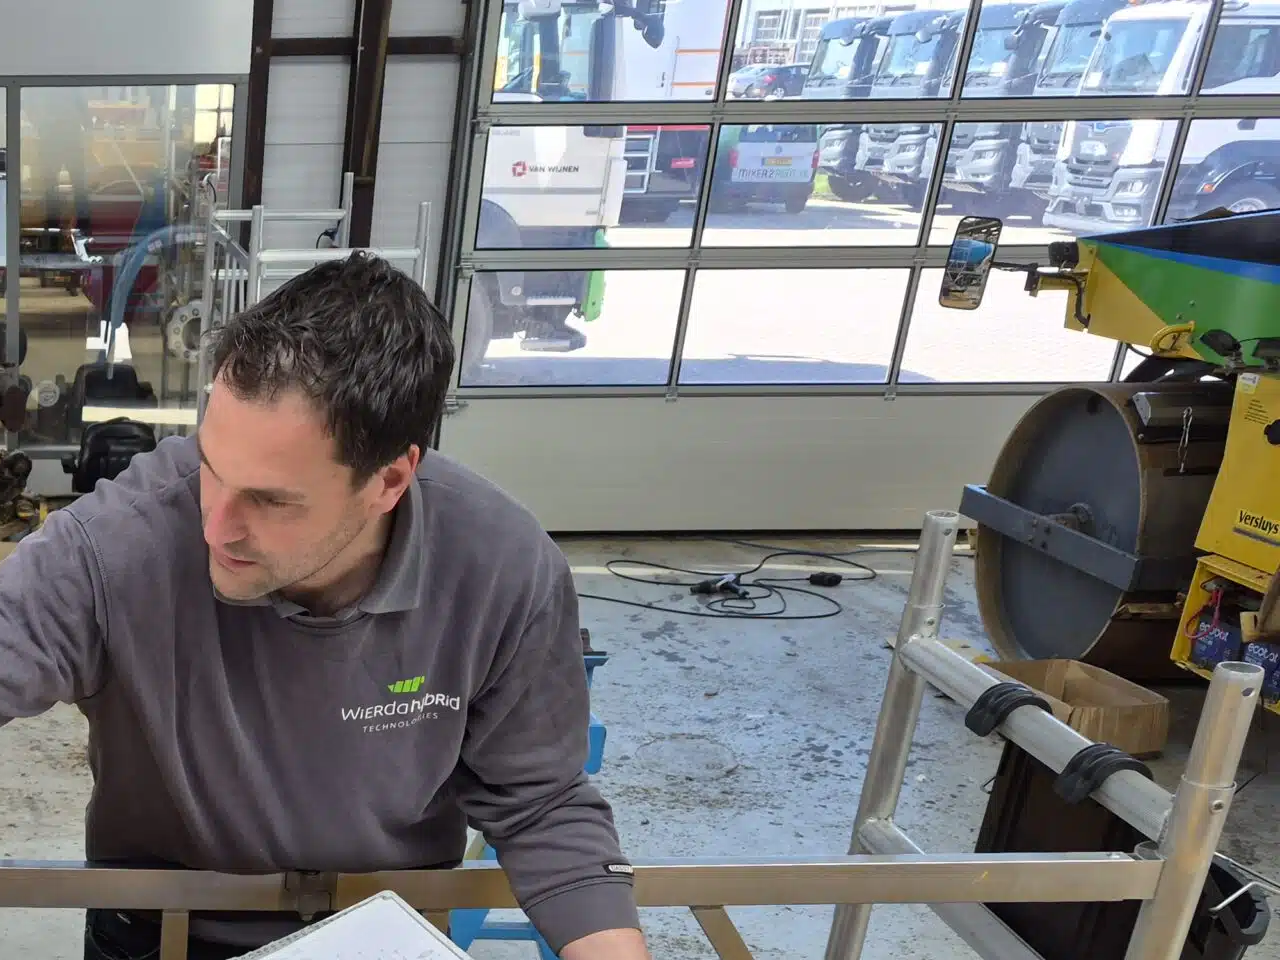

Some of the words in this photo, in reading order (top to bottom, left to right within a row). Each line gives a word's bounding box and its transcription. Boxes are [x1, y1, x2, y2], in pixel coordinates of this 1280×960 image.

[548, 165, 579, 173] WIJNEN
[1238, 509, 1280, 535] Versluys
[362, 712, 439, 733] TECHNOLOGIES
